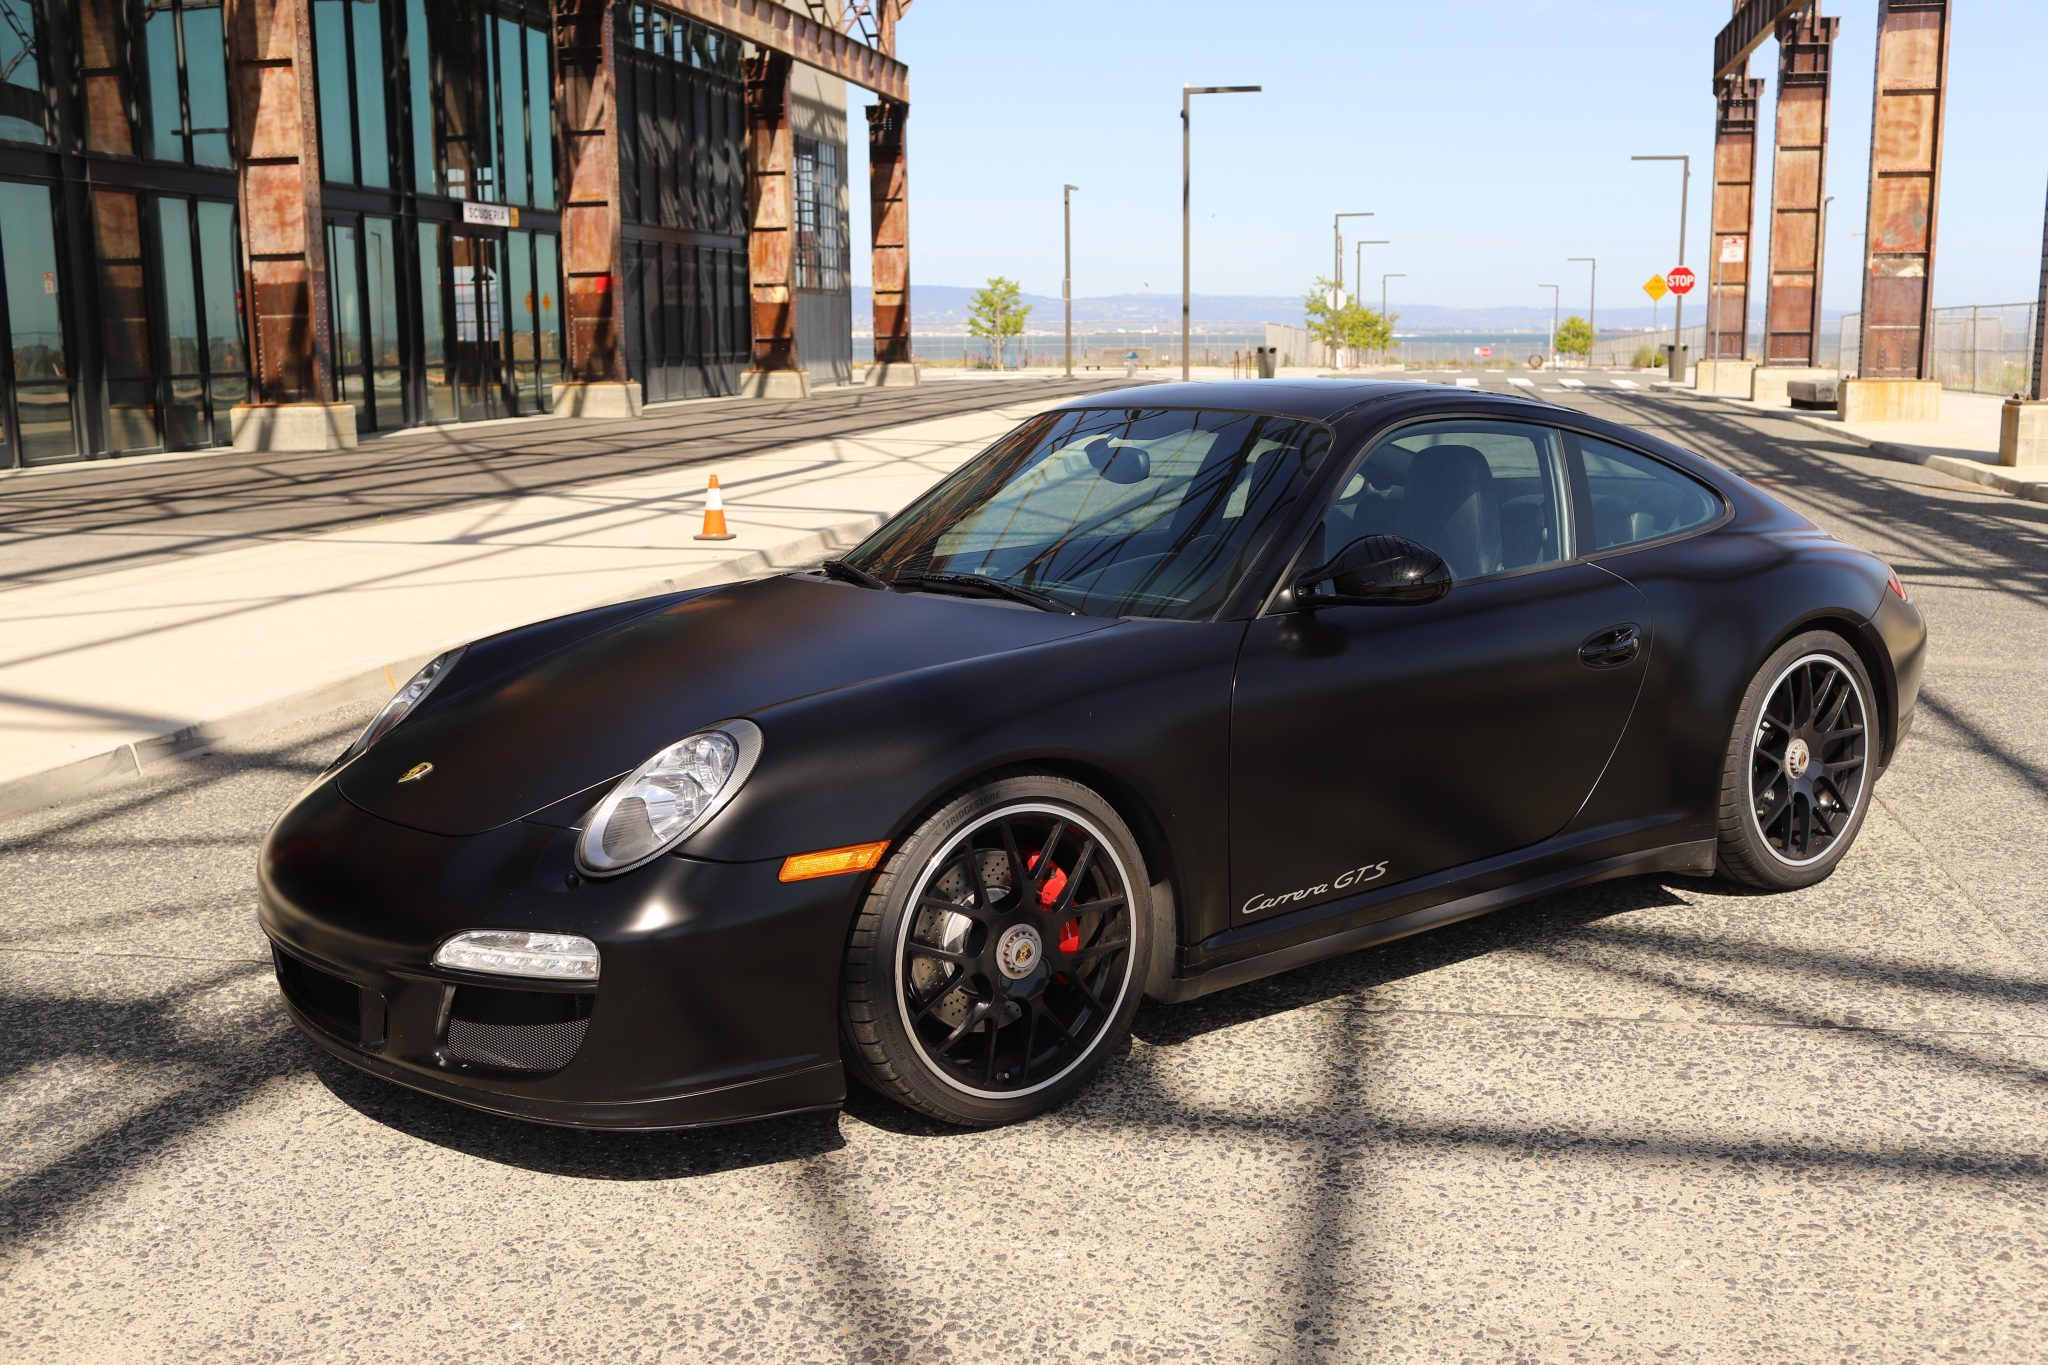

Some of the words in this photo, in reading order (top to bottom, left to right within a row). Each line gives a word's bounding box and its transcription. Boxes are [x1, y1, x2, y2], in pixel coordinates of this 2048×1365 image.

[468, 207, 505, 220] SCUDERIA
[1668, 275, 1694, 287] STOP
[942, 791, 1001, 831] BRIDGESTONE
[1242, 883, 1329, 914] Carrera
[1334, 860, 1389, 889] GTS
